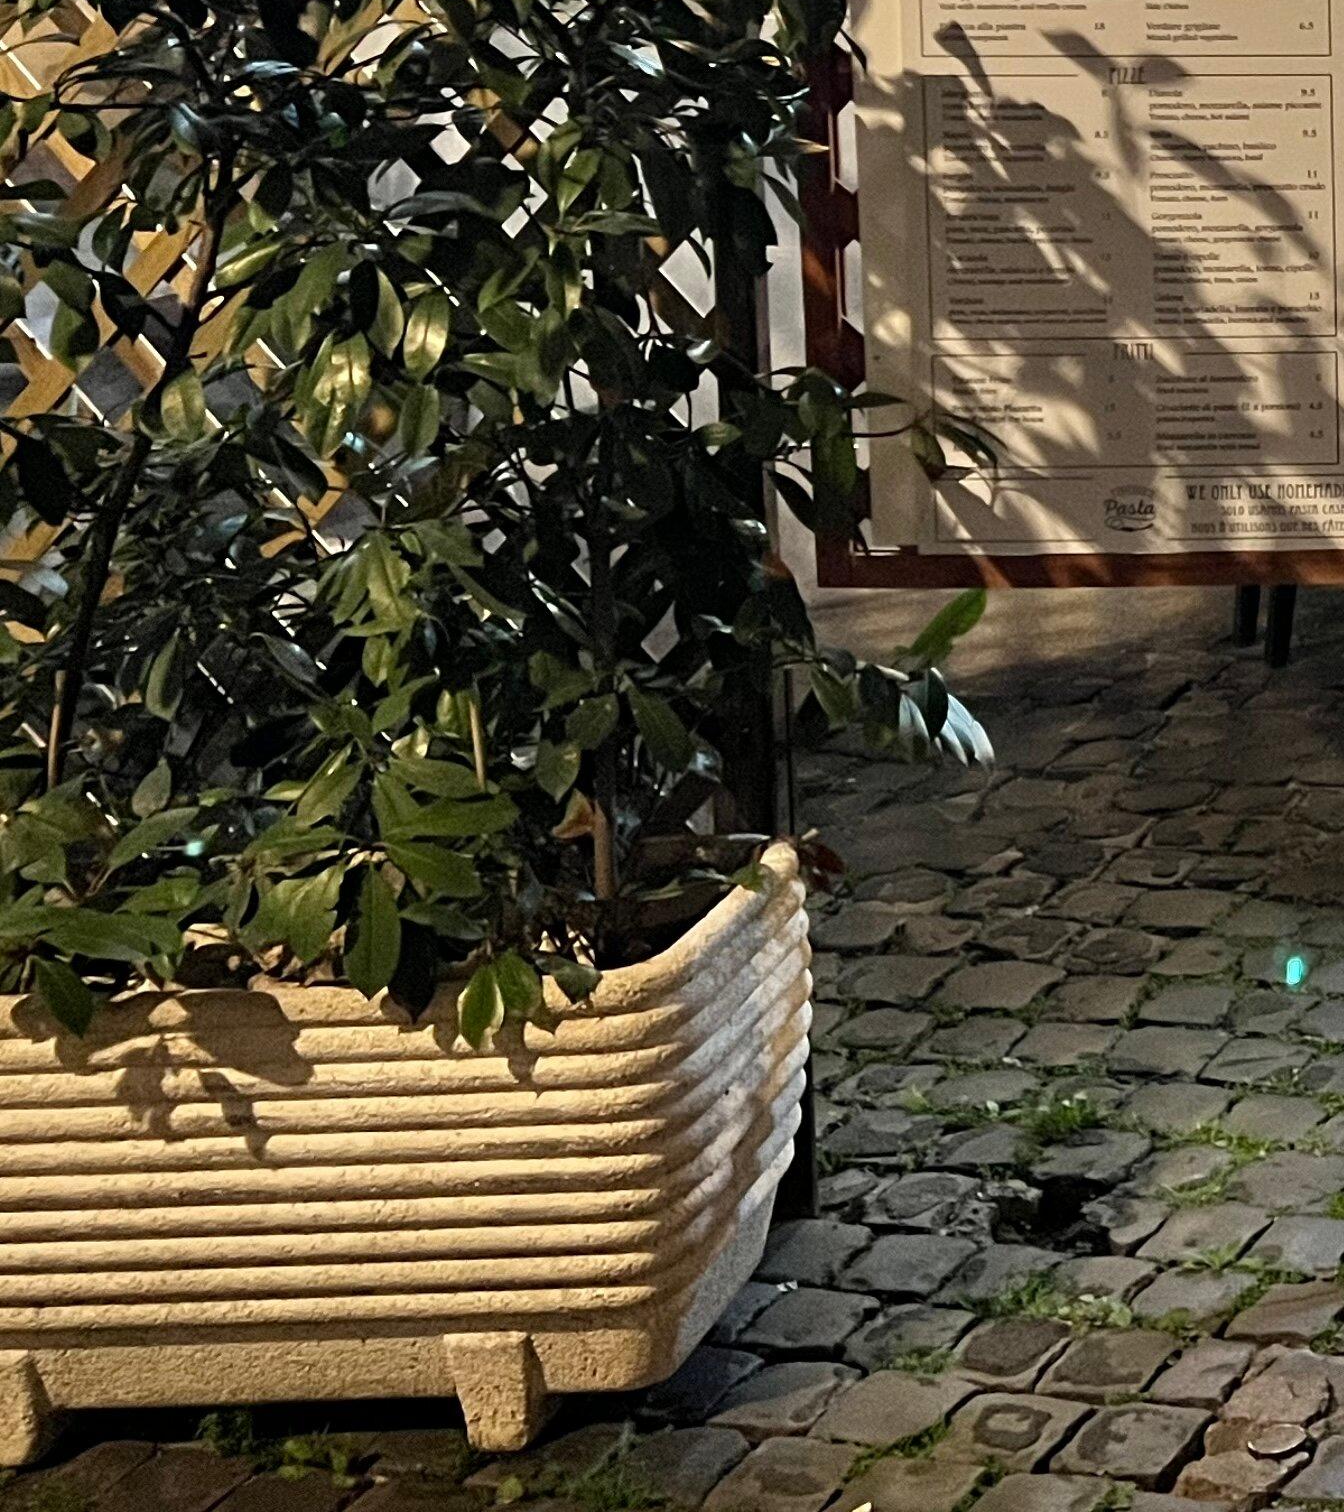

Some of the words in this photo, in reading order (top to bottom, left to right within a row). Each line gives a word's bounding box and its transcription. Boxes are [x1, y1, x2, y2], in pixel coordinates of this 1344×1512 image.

[1108, 67, 1146, 85] PIZZE
[1186, 484, 1206, 501] WE
[1211, 484, 1244, 501] ONLY
[1248, 484, 1273, 501] USE
[1104, 497, 1156, 517] Pasta
